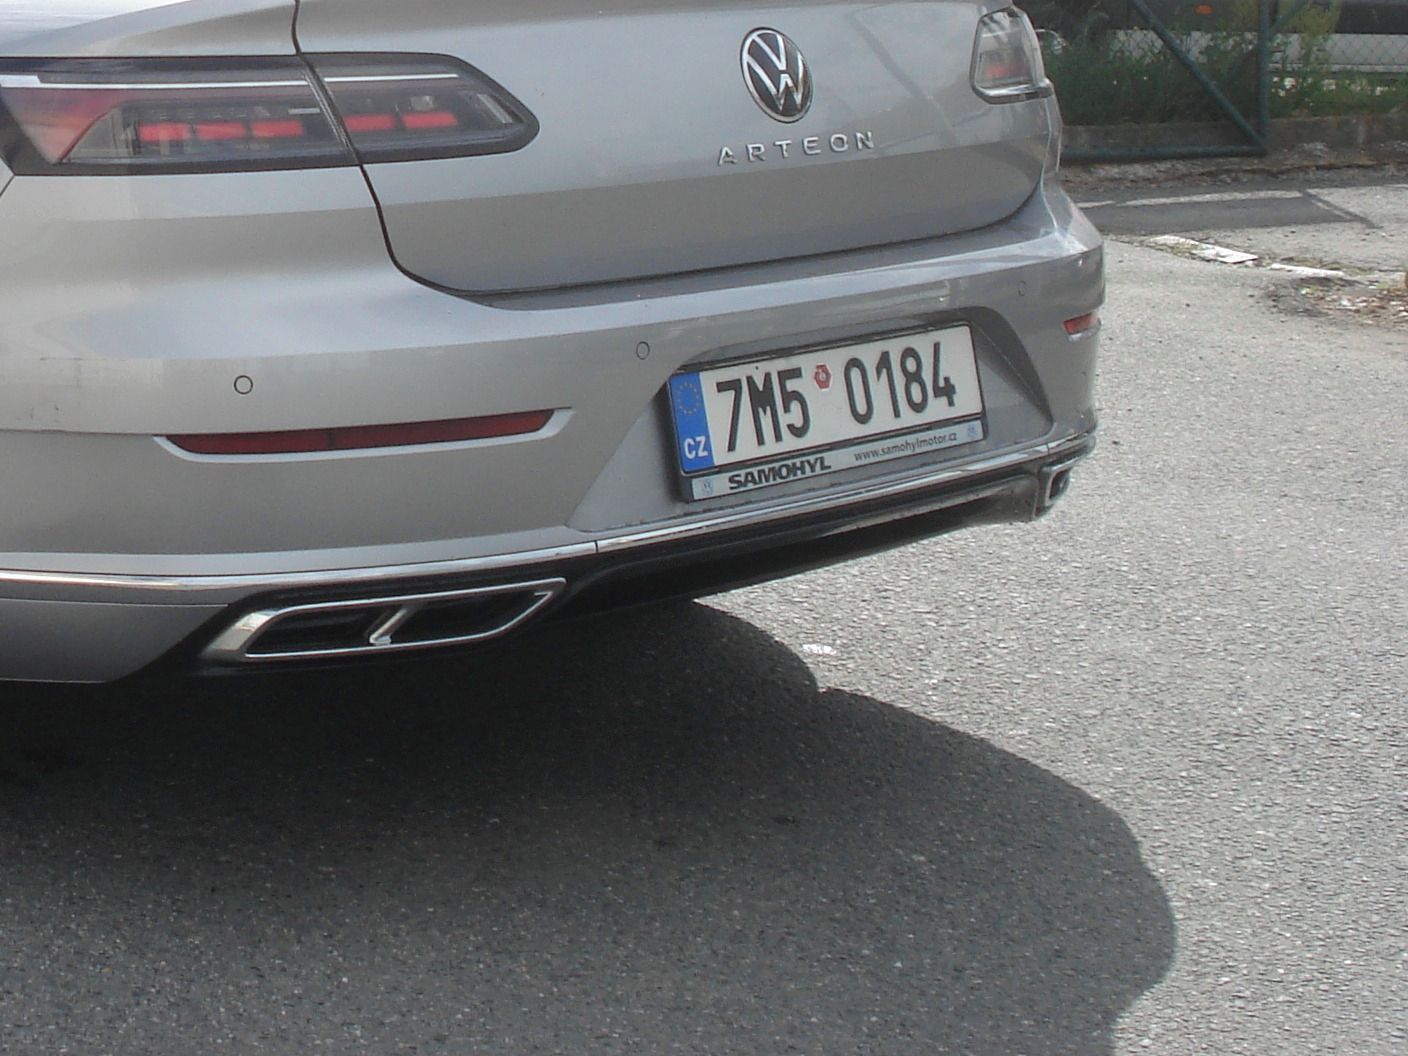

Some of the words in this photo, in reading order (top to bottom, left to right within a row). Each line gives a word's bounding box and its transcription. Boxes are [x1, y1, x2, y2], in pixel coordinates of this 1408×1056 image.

[718, 131, 875, 167] ARTEON
[716, 366, 811, 452] 7M5
[843, 341, 957, 425] 0184
[684, 435, 709, 460] CZ
[728, 456, 832, 491] SAMOHYL
[853, 432, 958, 462] www.samohylmotor.cz
